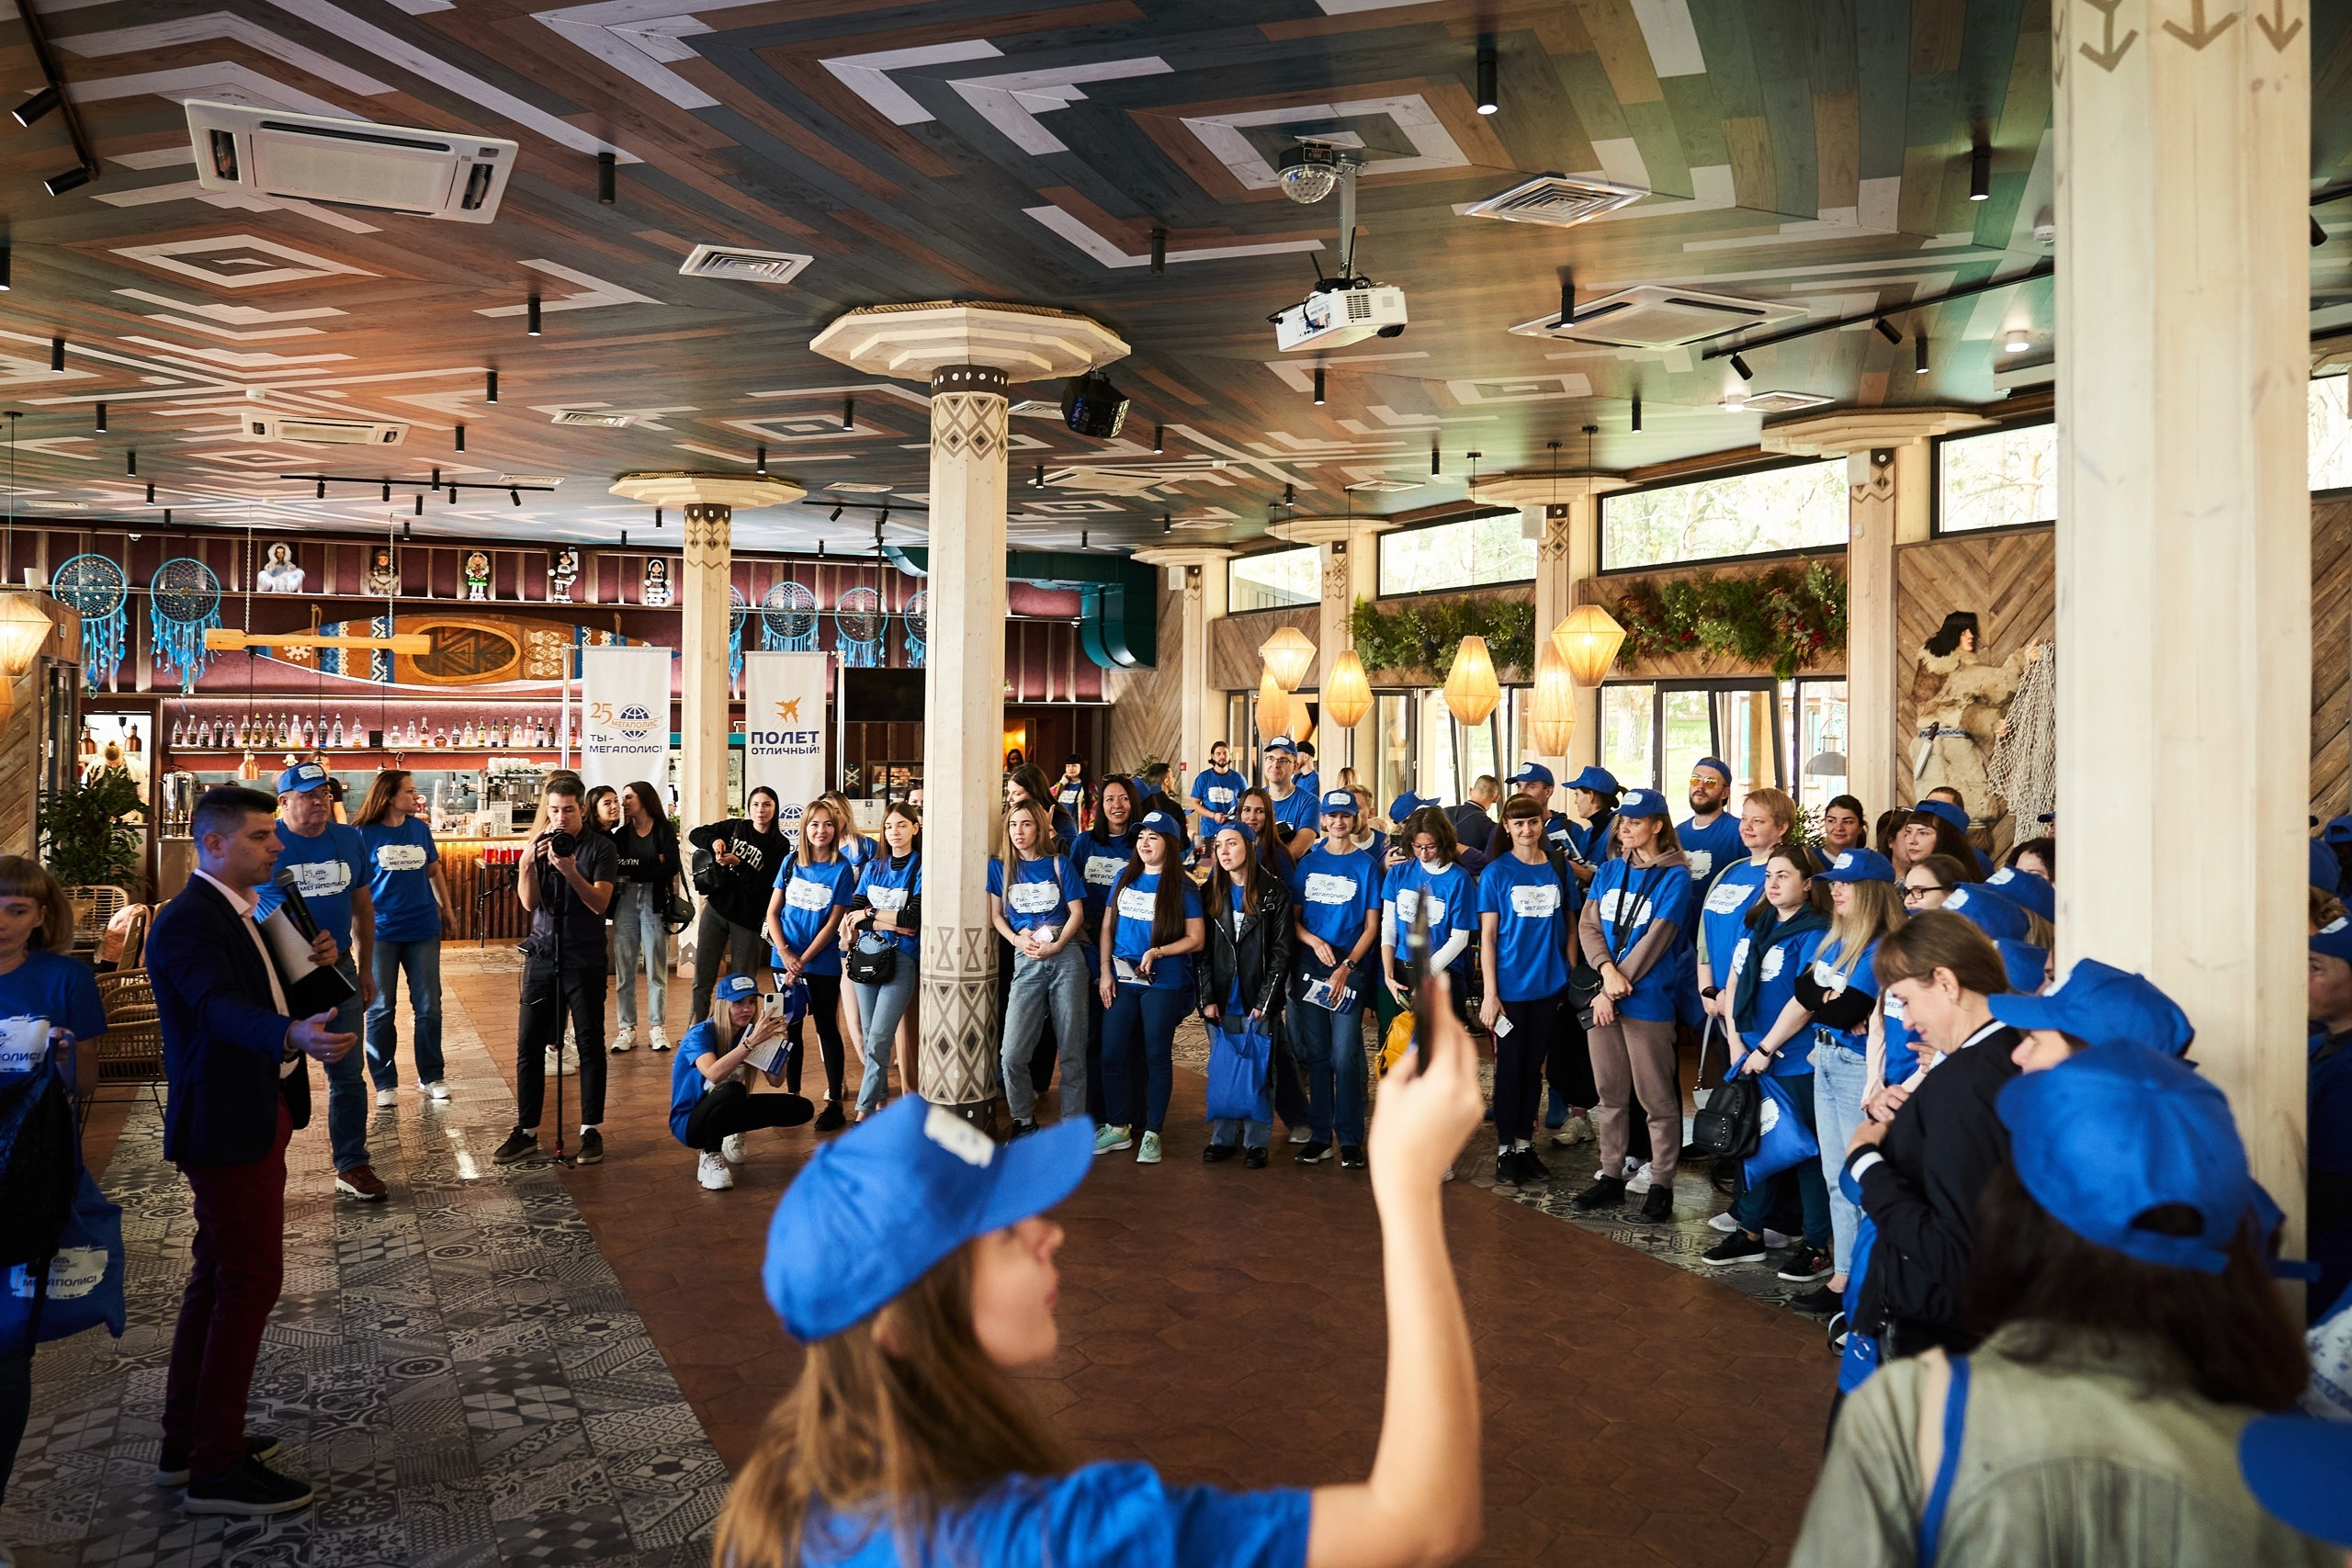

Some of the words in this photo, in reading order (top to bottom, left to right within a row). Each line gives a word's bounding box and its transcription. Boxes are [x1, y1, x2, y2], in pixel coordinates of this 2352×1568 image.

[589, 702, 614, 726] 25
[611, 719, 658, 728] МЕГАПОЛИС
[590, 734, 607, 742] ТЫ
[751, 731, 820, 744] ПОЛЕТ
[589, 745, 662, 753] МЕГАПОЛИС!
[751, 745, 820, 755] ОТЛИЧНЫЙ!
